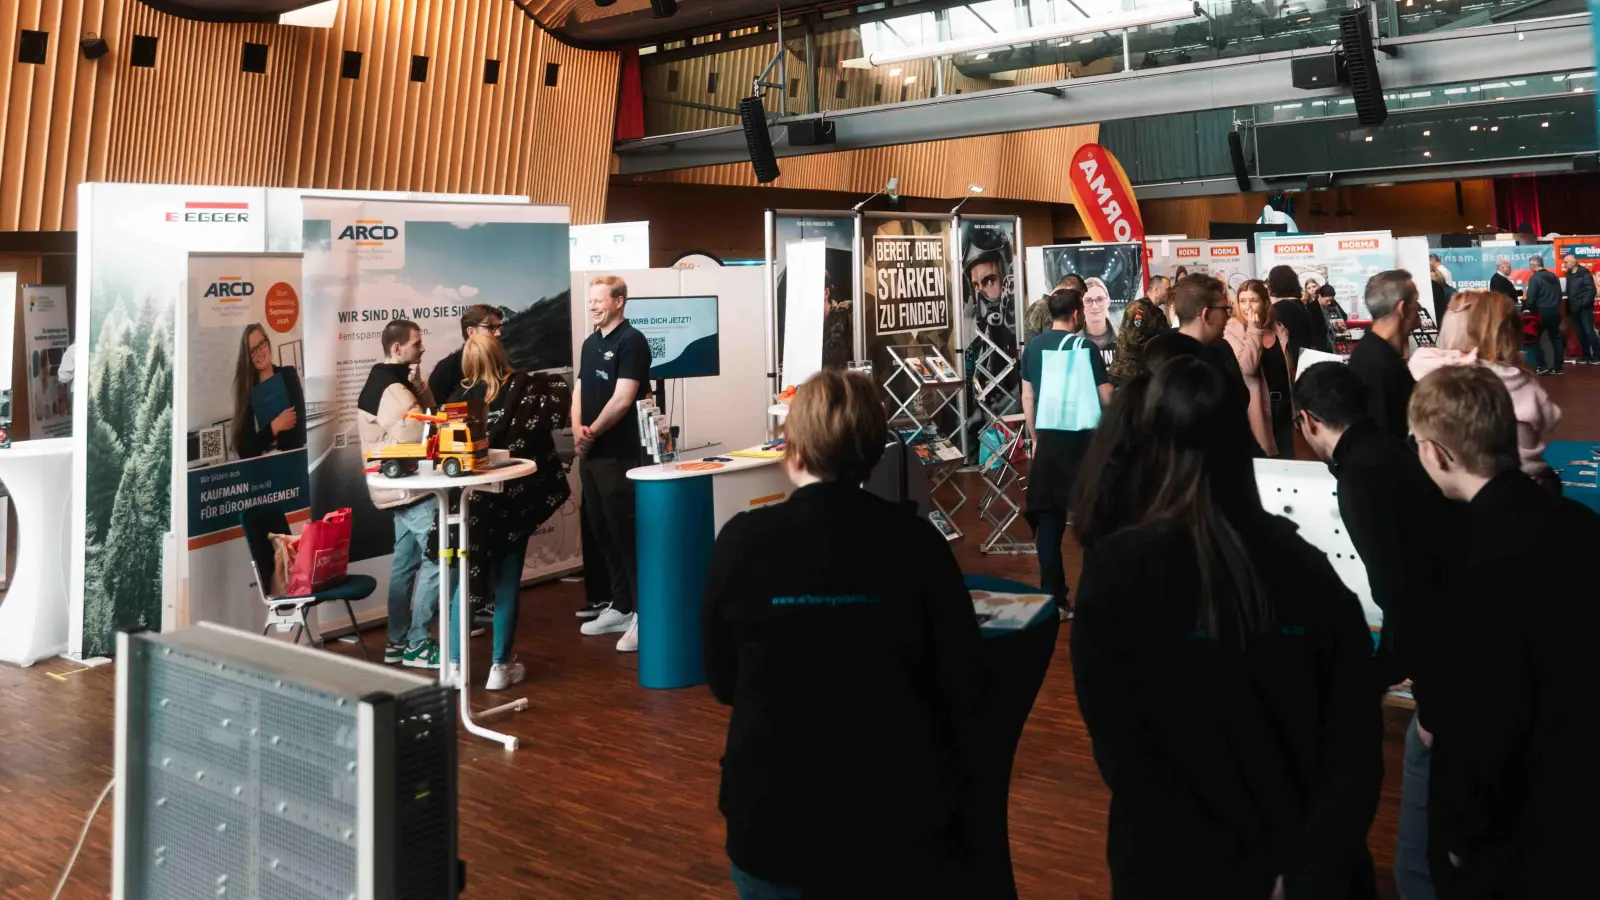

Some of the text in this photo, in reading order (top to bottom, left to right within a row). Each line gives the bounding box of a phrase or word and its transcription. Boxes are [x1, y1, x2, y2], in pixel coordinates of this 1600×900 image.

[184, 212, 249, 222] EGGER
[338, 225, 399, 240] ARCD
[1277, 245, 1311, 253] NORMA
[1341, 240, 1375, 248] NORMA
[876, 241, 942, 263] BEREIT, DEINE
[1178, 248, 1199, 256] NORMA
[1212, 247, 1237, 255] NORMA
[878, 262, 944, 300] STÄRKEN
[1458, 280, 1487, 288] GEORG
[203, 282, 255, 297] ARCD
[338, 305, 472, 323] WIR SIND DA, WO SIE SIN
[651, 317, 668, 325] DICH
[669, 316, 692, 324] JETZT!
[880, 300, 946, 329] ZU FINDEN?
[337, 330, 382, 342] #entspann
[200, 482, 249, 503] KAUFMANN
[200, 487, 300, 520] FÜR BÜROMANAGEMENT
